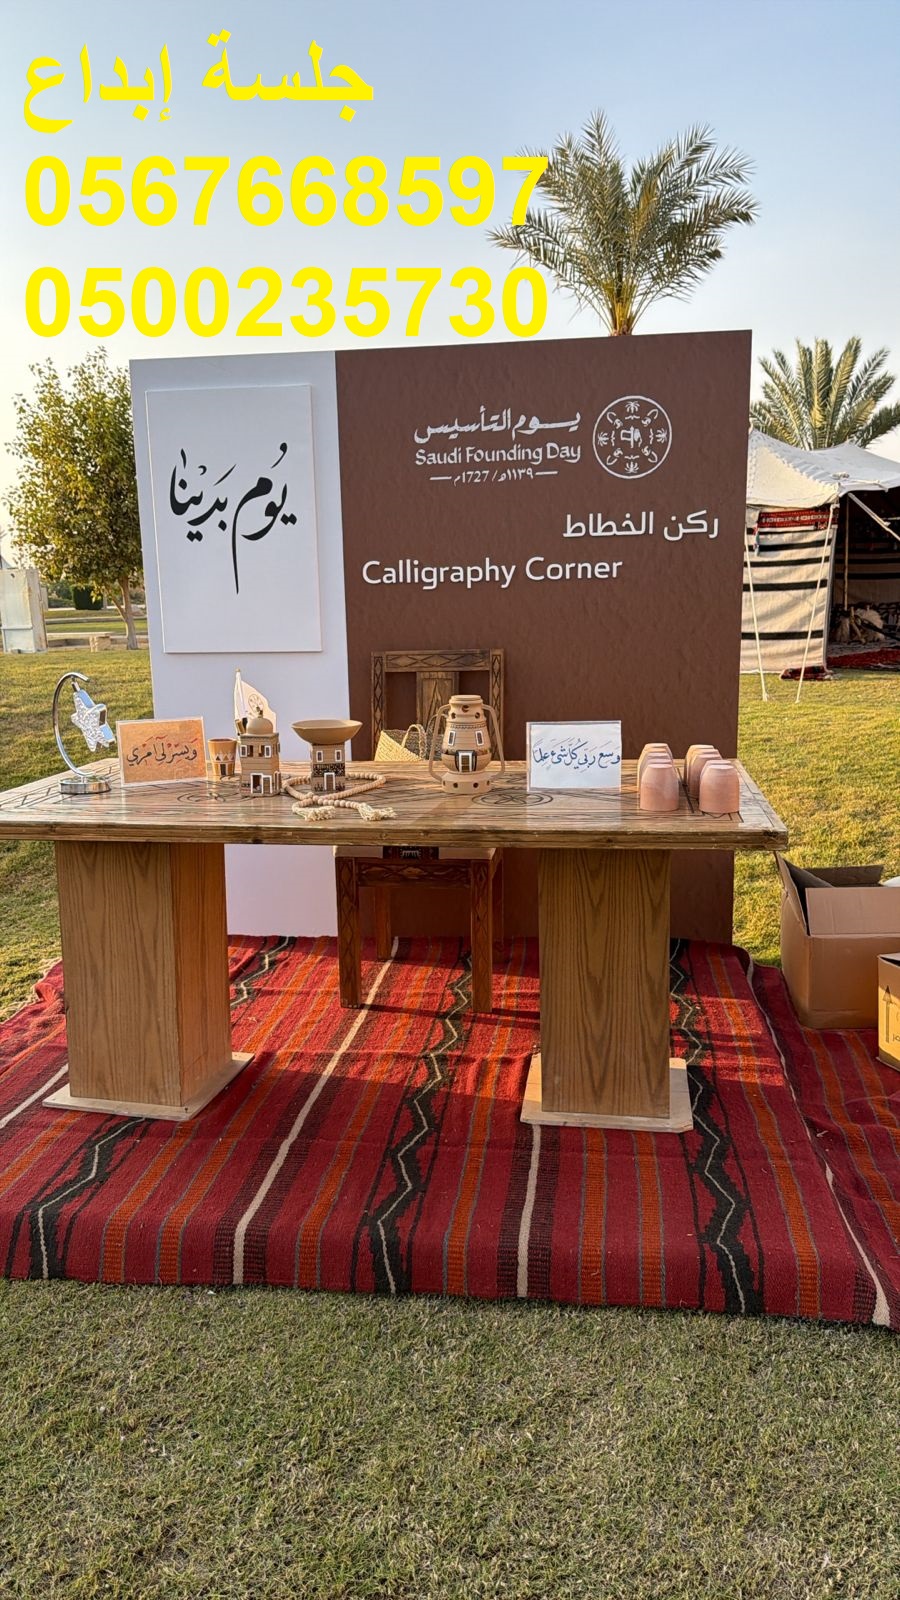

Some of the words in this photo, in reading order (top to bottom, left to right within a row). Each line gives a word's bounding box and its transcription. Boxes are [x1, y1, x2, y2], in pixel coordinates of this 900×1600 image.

[413, 405, 511, 444] التأسيس
[512, 412, 581, 441] يوم
[415, 447, 462, 466] Saudi
[465, 443, 543, 466] Founding
[546, 442, 581, 464] Day
[562, 511, 654, 538] الخطاط
[663, 509, 720, 541] ركن
[362, 557, 516, 590] Calligraphy
[525, 556, 623, 581] Corner
